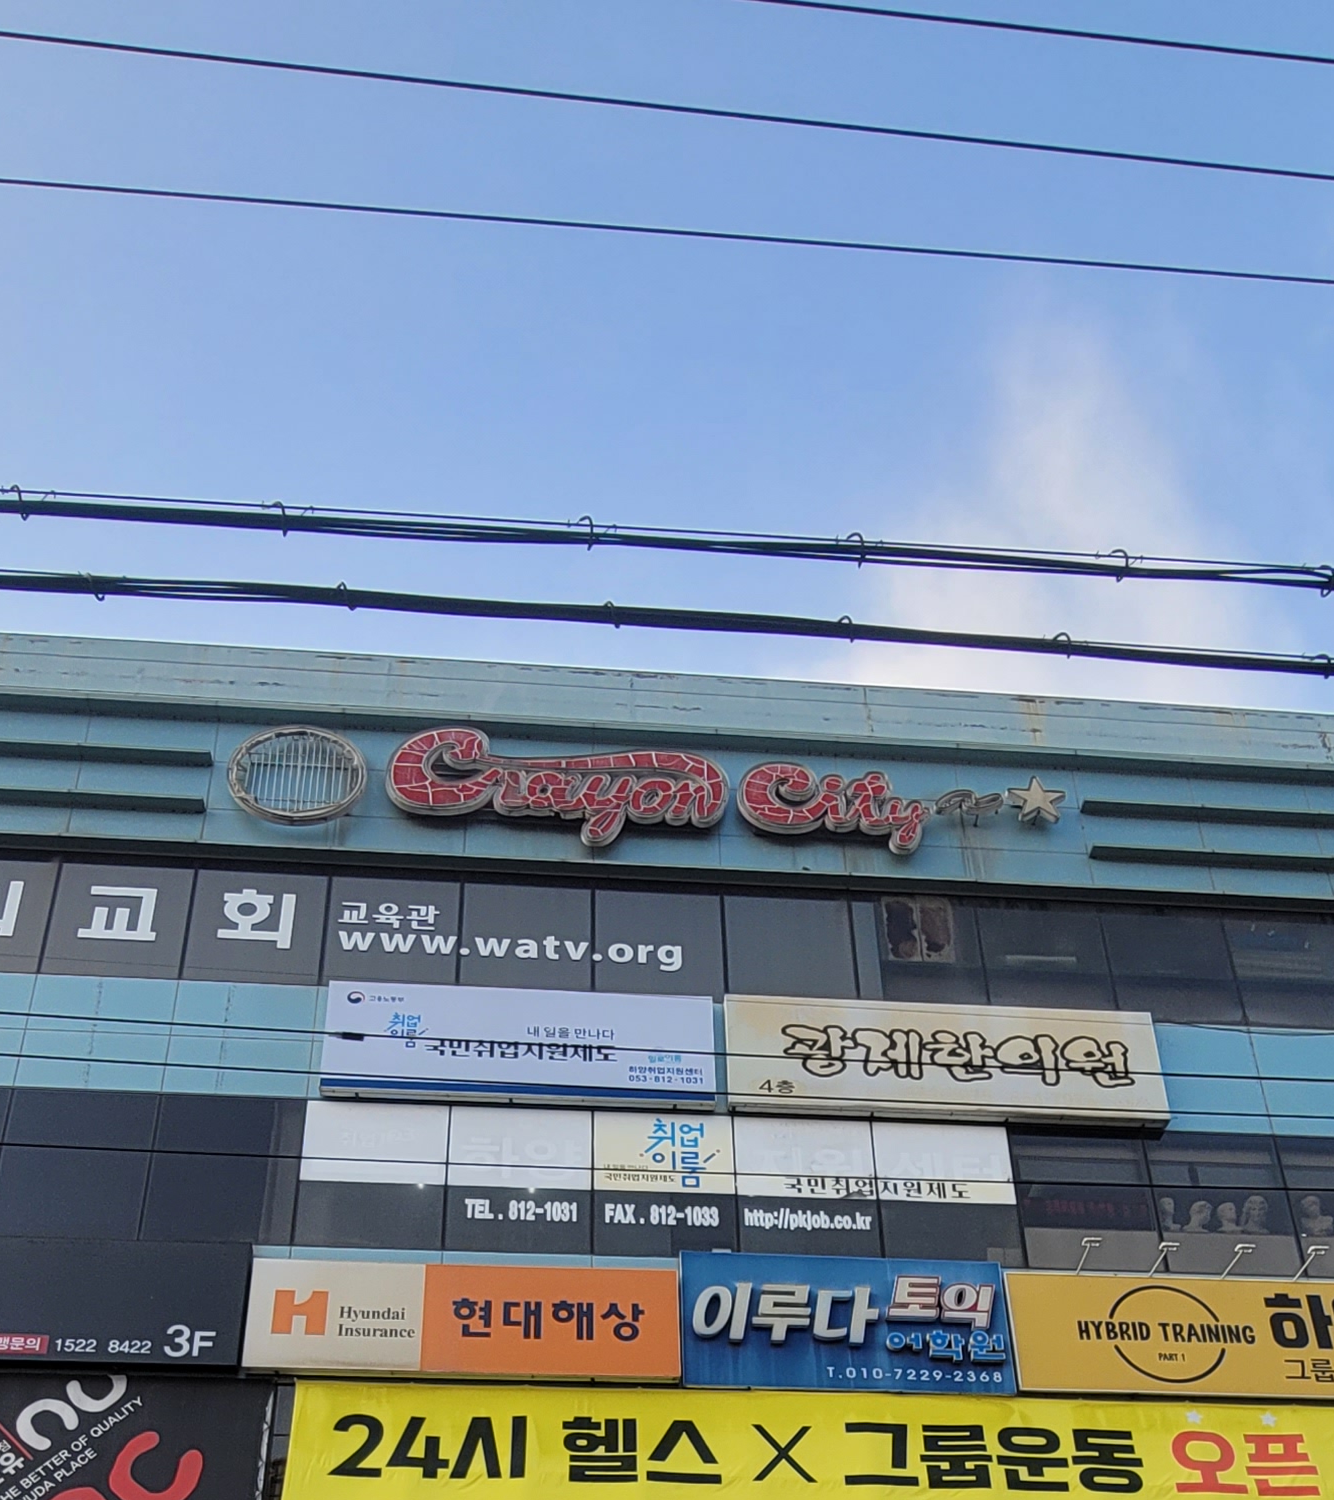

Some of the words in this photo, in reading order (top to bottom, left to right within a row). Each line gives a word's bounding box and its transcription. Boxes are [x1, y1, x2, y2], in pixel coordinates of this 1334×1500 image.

[338, 901, 441, 931] 교육관
[338, 926, 684, 971] www.watv.org
[387, 1011, 421, 1030] 취업
[574, 1028, 615, 1041] 만나다
[423, 1037, 618, 1063] 국민취업지원제도
[758, 1079, 796, 1095] 4층
[645, 1118, 705, 1155] 취업
[783, 1177, 972, 1200] 국민취업지원제도
[508, 1200, 578, 1222] 812-1031
[649, 1205, 719, 1227] 812-1033
[338, 1304, 407, 1330] Hyundai
[451, 1297, 646, 1343] 현대해상
[692, 1279, 881, 1347] 이루다
[886, 1275, 998, 1331] 토익
[54, 1337, 97, 1353] 1522
[107, 1338, 152, 1355] 8422
[163, 1324, 217, 1358] 3F
[337, 1323, 416, 1343] Insurance
[886, 1330, 1007, 1363] 어학원
[1077, 1318, 1151, 1345] HYBRID
[1157, 1319, 1255, 1347] TRAINING
[1157, 1350, 1177, 1362] PART
[19, 1450, 71, 1490] BETTER
[70, 1434, 90, 1456] OF
[89, 1396, 144, 1438] QUALITY
[327, 1412, 527, 1480] 24시
[562, 1415, 723, 1485] 헬스
[845, 1420, 1144, 1494] 그룹운동
[1171, 1430, 1321, 1497] 오픈
[53, 1446, 98, 1484] PLACE
